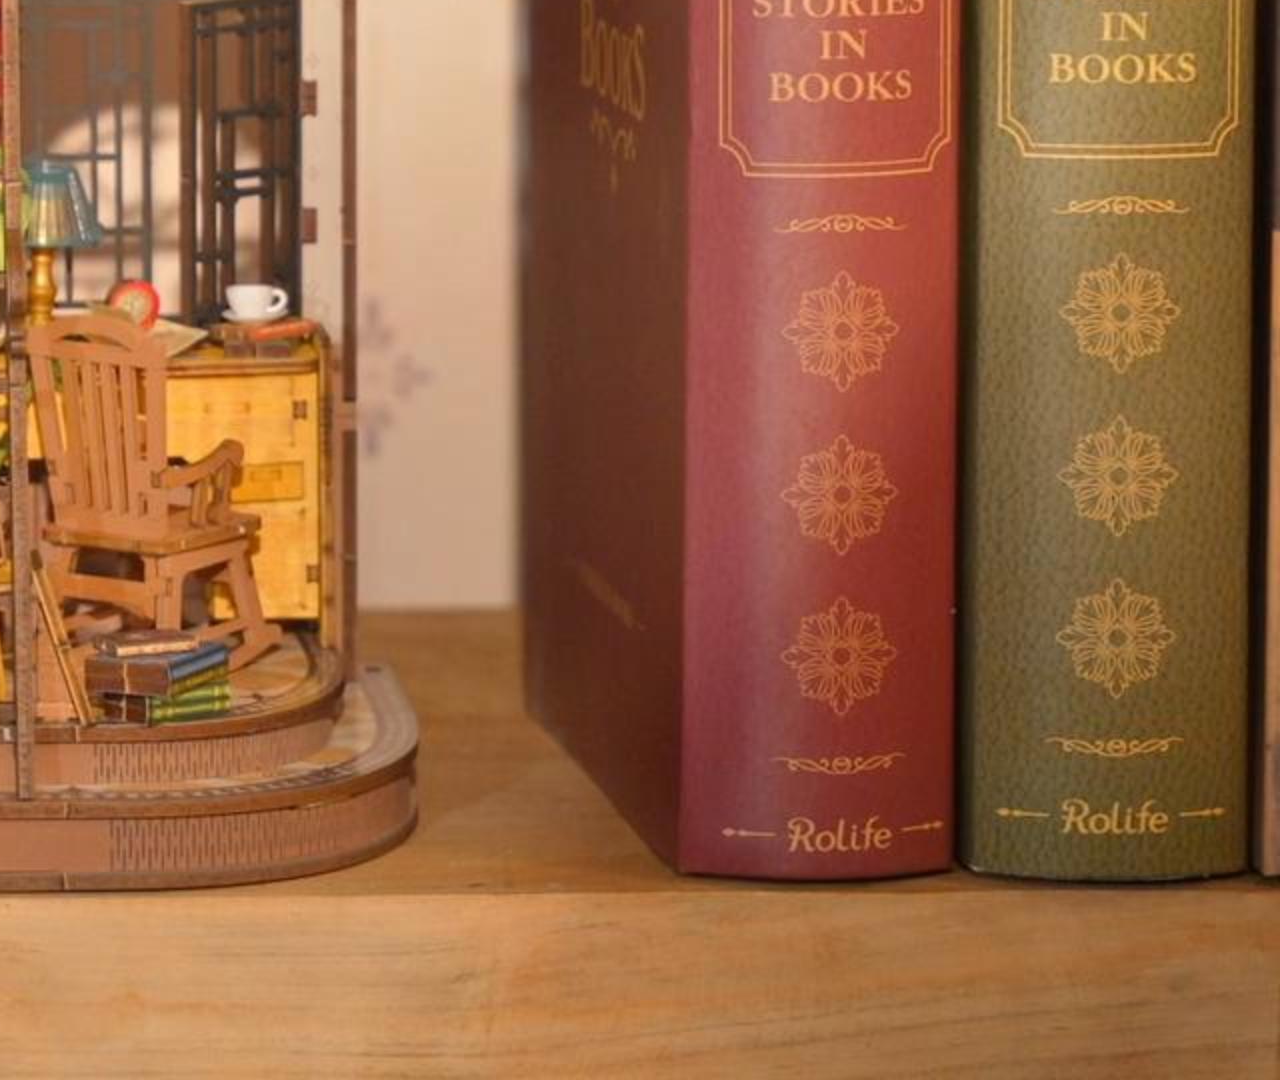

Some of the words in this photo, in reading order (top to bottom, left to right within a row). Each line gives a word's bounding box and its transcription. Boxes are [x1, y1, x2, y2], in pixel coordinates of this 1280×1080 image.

[1101, 10, 1149, 41] IN
[820, 29, 867, 60] IN
[1049, 52, 1196, 84] BOOKS
[768, 69, 912, 103] BOOKS
[1062, 798, 1169, 836] Rolife
[787, 816, 894, 854] Rolife
